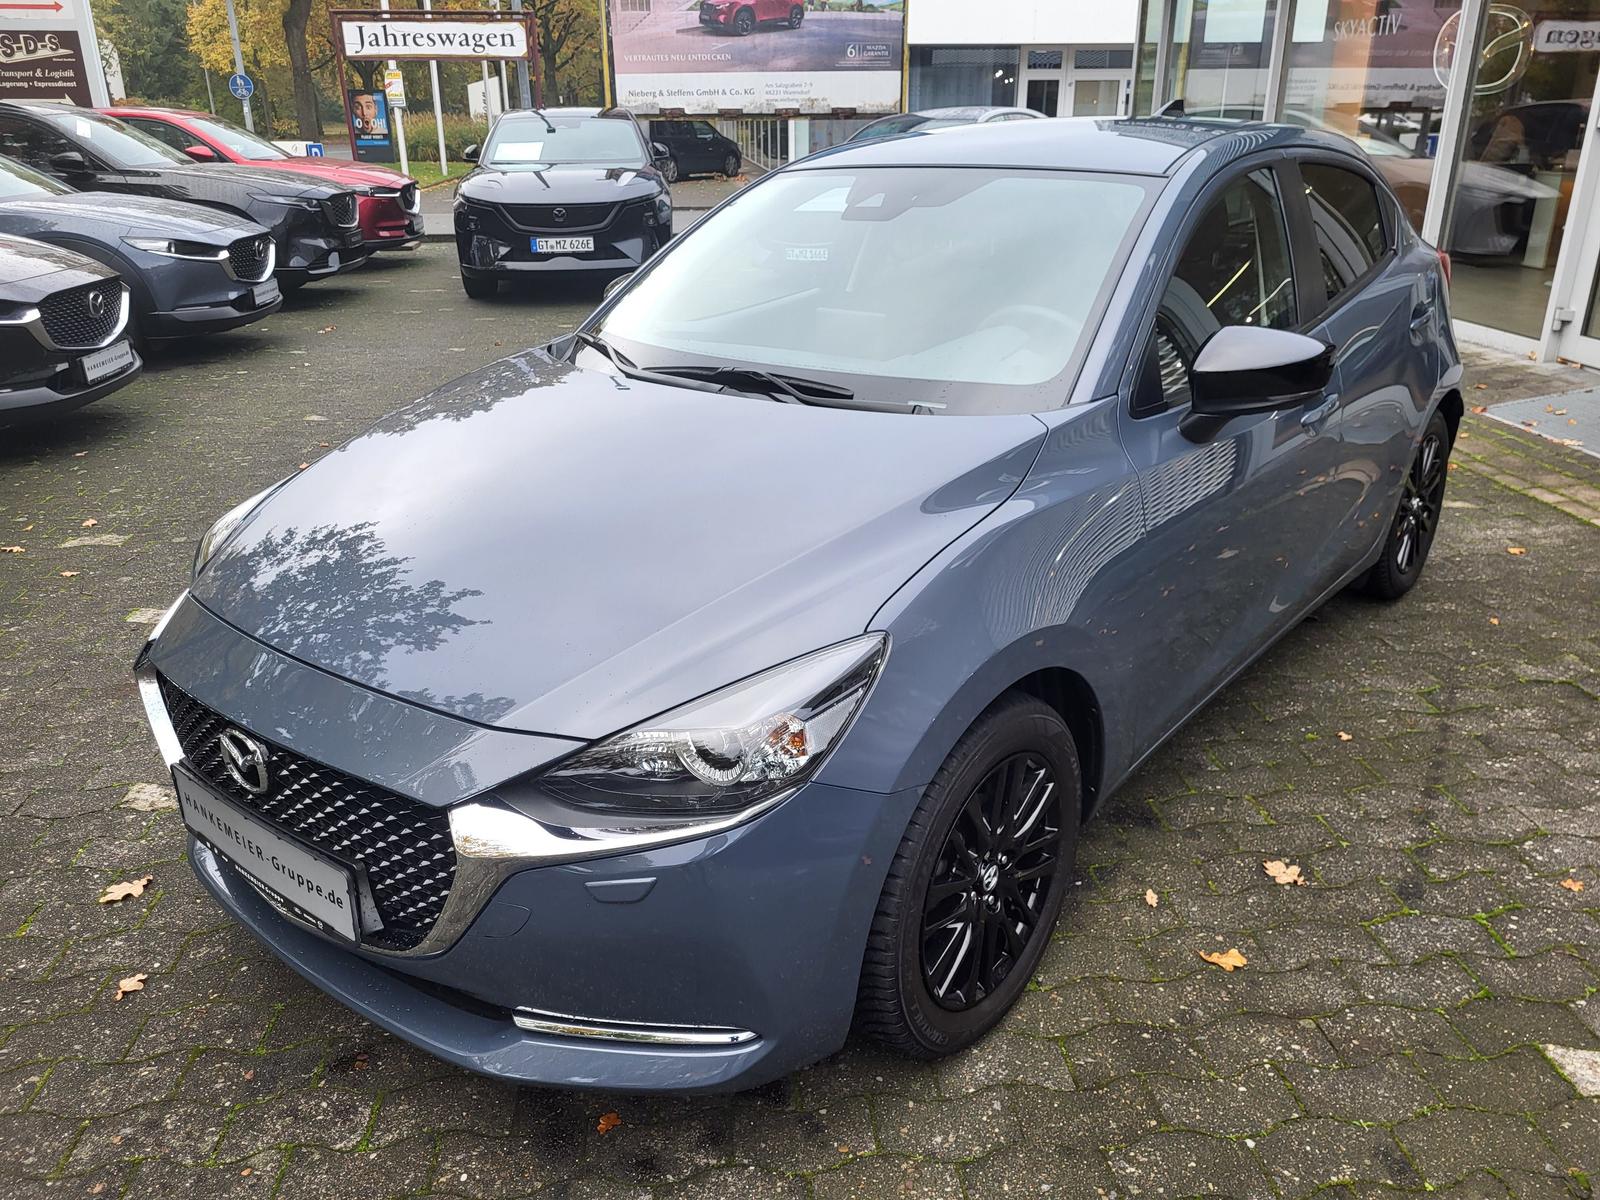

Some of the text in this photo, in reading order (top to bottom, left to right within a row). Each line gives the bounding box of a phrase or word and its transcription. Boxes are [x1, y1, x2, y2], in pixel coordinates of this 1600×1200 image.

[1333, 14, 1402, 41] SKYACTIV
[355, 24, 516, 54] Jahreswagen
[847, 44, 856, 58] 6
[624, 53, 732, 62] VERTRAUTES NEU ENTDECKEN
[0, 68, 75, 79] ransport & Logistik
[628, 88, 755, 98] Nieberg & Steffens GmbH & Co. KG
[538, 239, 592, 250] GT MZ 626E
[184, 792, 344, 910] HANKEMEIER-Gruppe.de
